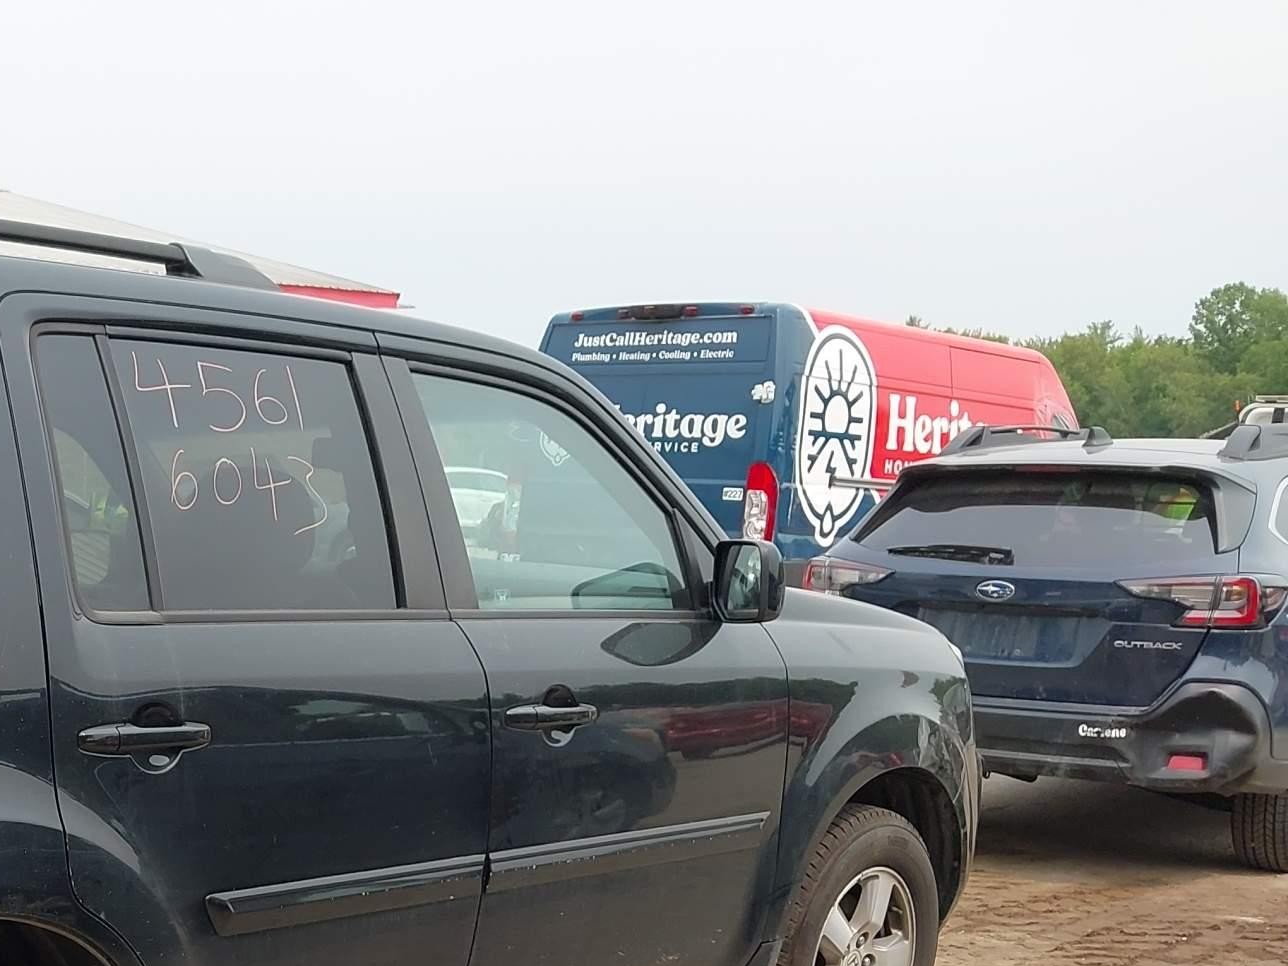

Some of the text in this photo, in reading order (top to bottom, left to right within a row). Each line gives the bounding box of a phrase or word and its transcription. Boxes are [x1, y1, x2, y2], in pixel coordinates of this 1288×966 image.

[572, 349, 734, 361] Plumbing Heating Cooling Electric
[574, 330, 738, 347] JustCallHeritage.com
[131, 351, 304, 432] 4561
[885, 393, 985, 455] Herit
[171, 447, 328, 535] 6043
[1114, 640, 1182, 650] OUTBACK
